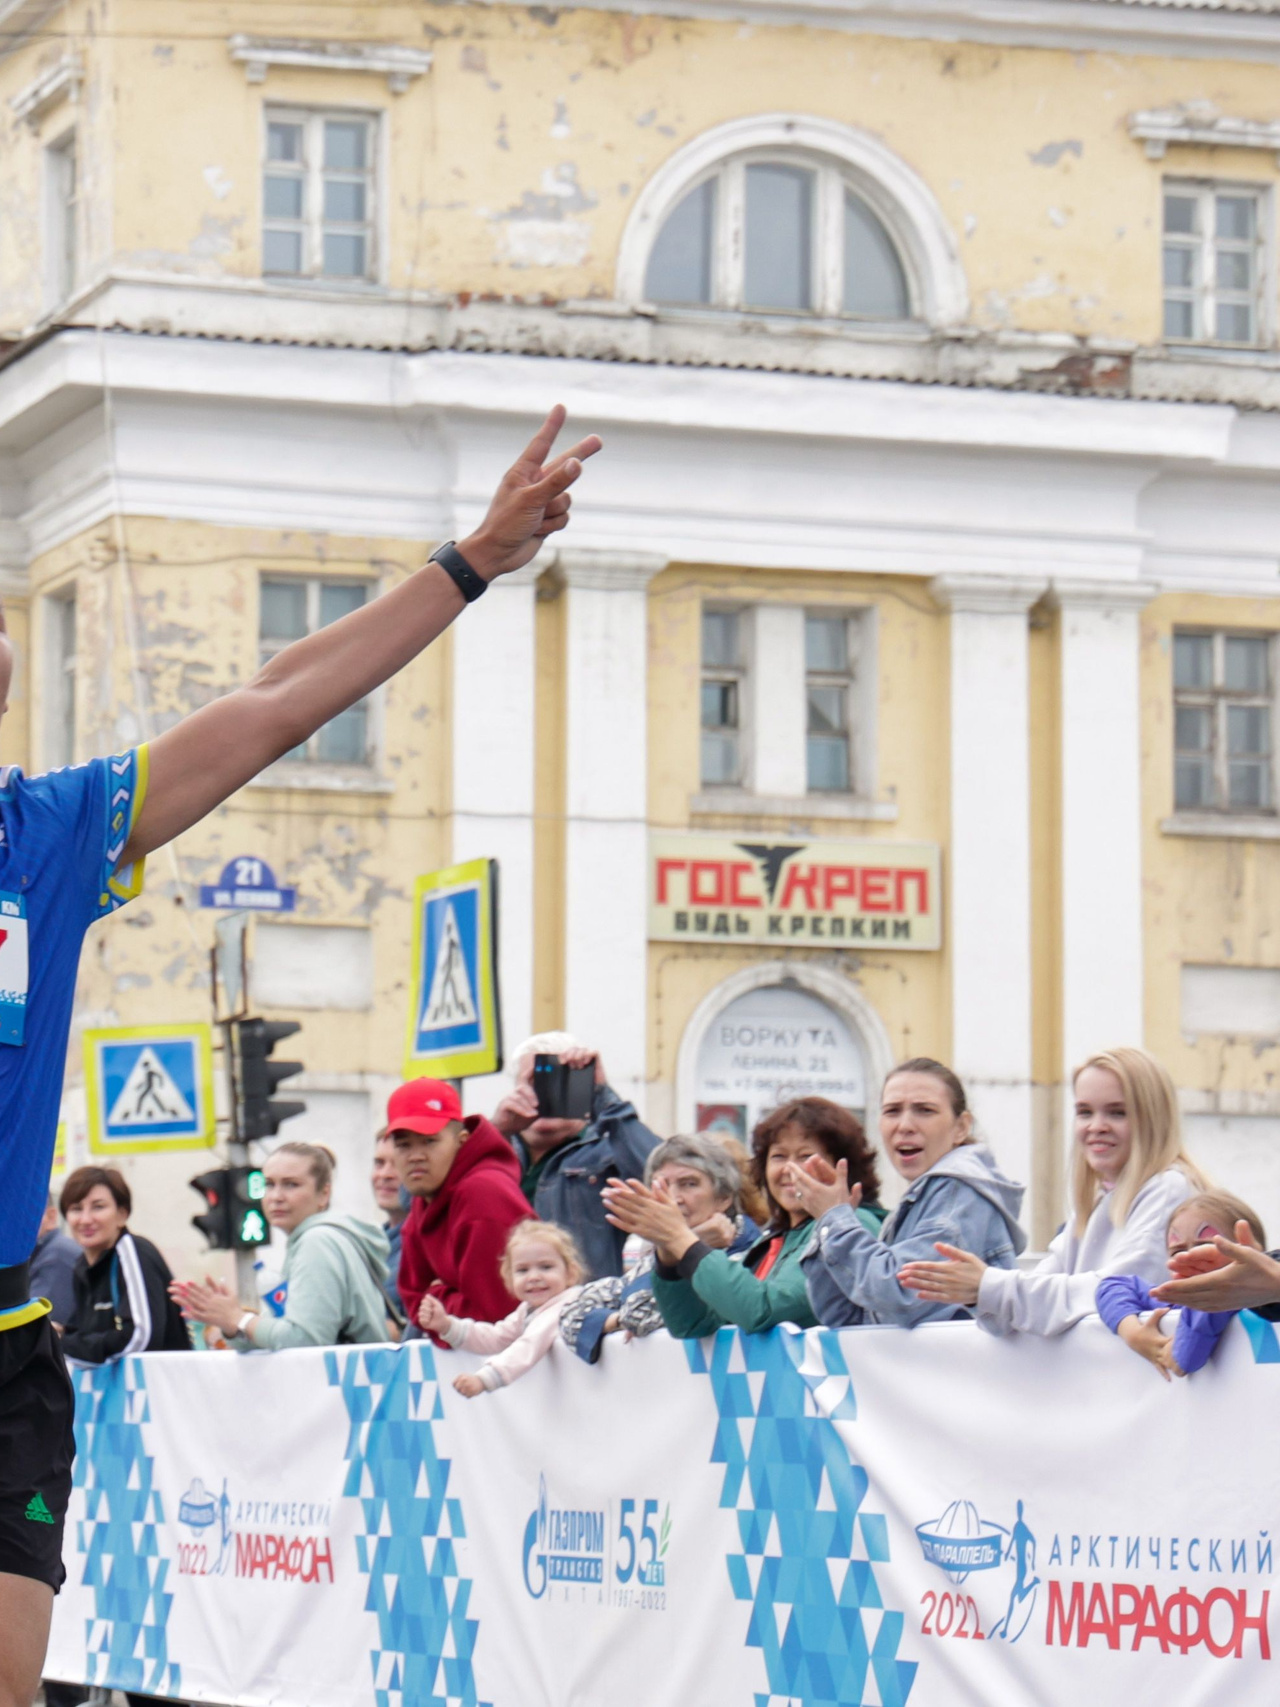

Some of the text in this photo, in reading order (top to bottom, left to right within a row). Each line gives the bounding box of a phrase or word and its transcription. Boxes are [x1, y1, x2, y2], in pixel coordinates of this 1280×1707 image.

[235, 859, 261, 886] 21
[674, 911, 911, 940] БУДЬ КРЕПКИМ
[549, 1510, 604, 1553] ГАЗПРОМ
[616, 1498, 658, 1585] 55
[1048, 1530, 1271, 1574] АРКТИЧЕСКИЙ
[235, 1533, 334, 1584] МАРАФОН
[550, 1558, 602, 1580] ТРАНСГАЗ
[920, 1590, 985, 1640] 2022
[1045, 1580, 1271, 1660] МАРАФОН
